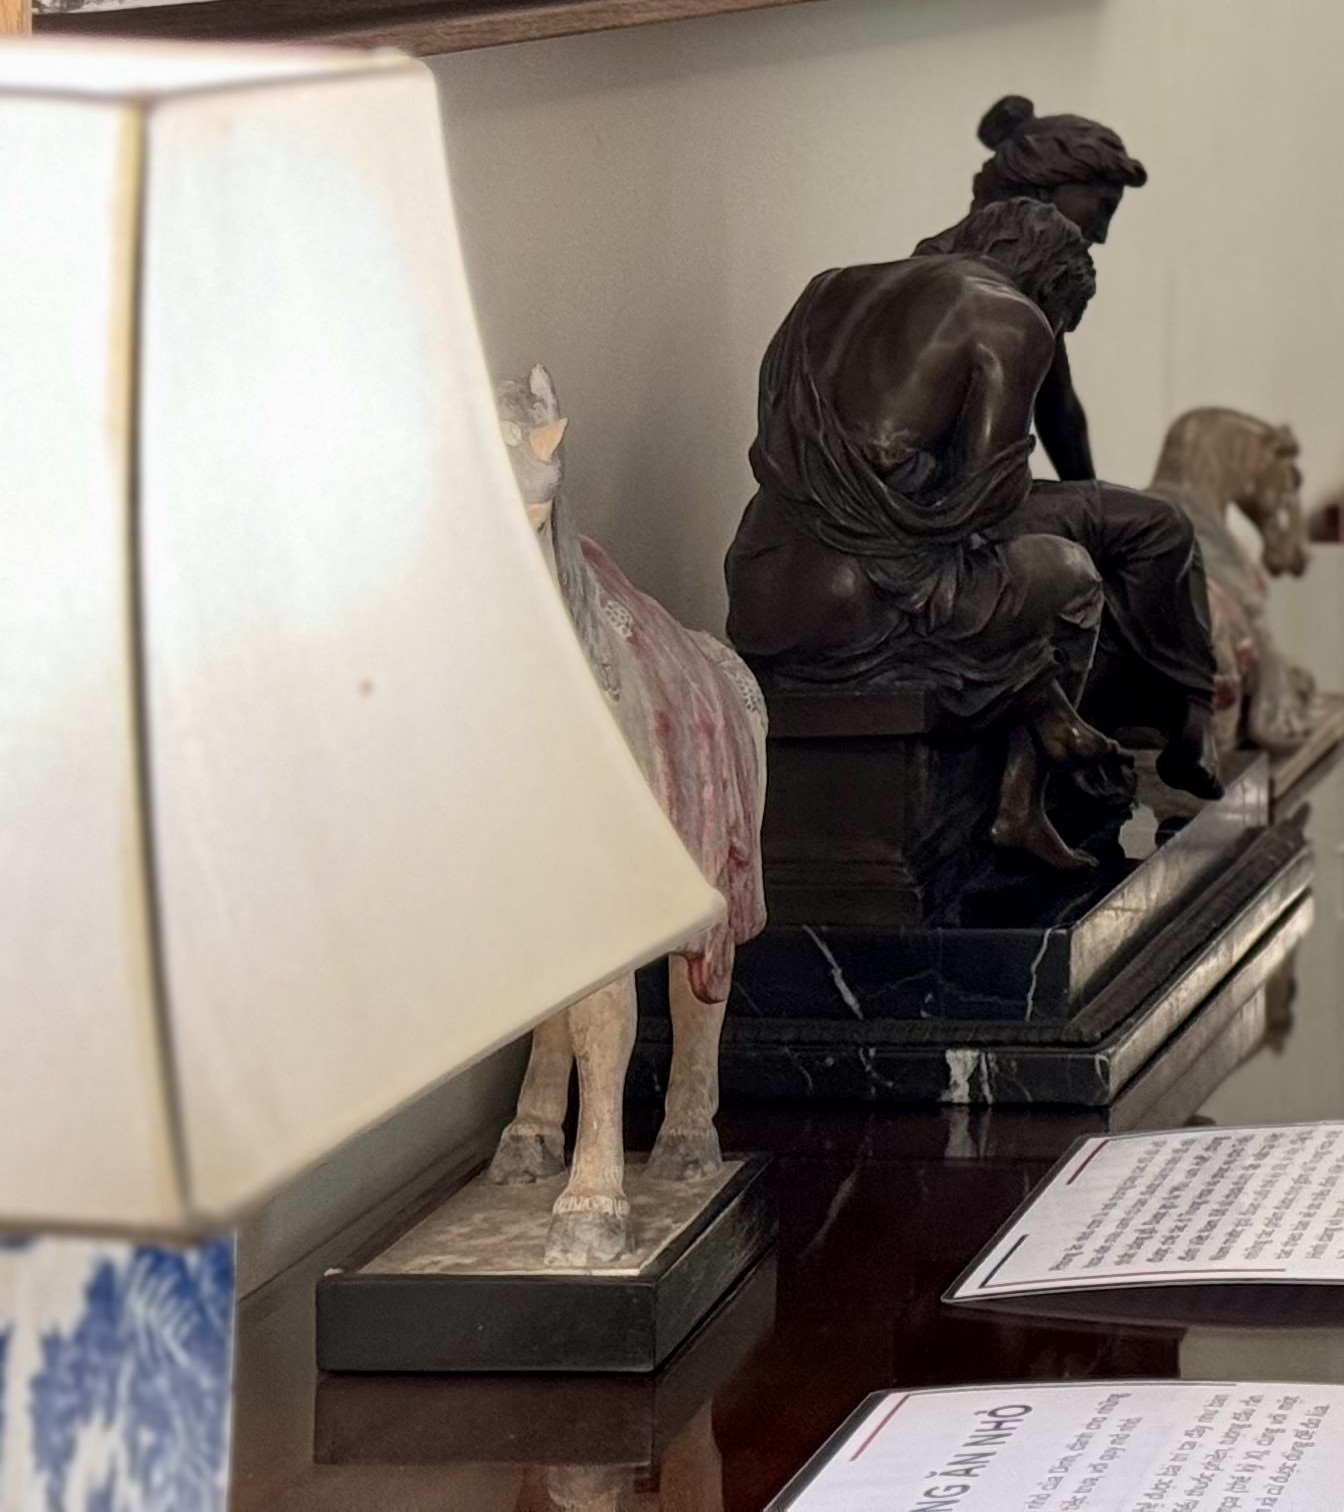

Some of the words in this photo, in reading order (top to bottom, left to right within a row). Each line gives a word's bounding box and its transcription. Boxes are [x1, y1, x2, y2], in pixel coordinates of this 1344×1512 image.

[925, 1451, 997, 1479] ĂN
[963, 1404, 1032, 1447] NHỎ
[1036, 1476, 1065, 1491] của
[1085, 1416, 1108, 1431] cho
[1183, 1472, 1216, 1497] thuốc
[1268, 1462, 1299, 1484] được
[1143, 1478, 1176, 1500] được
